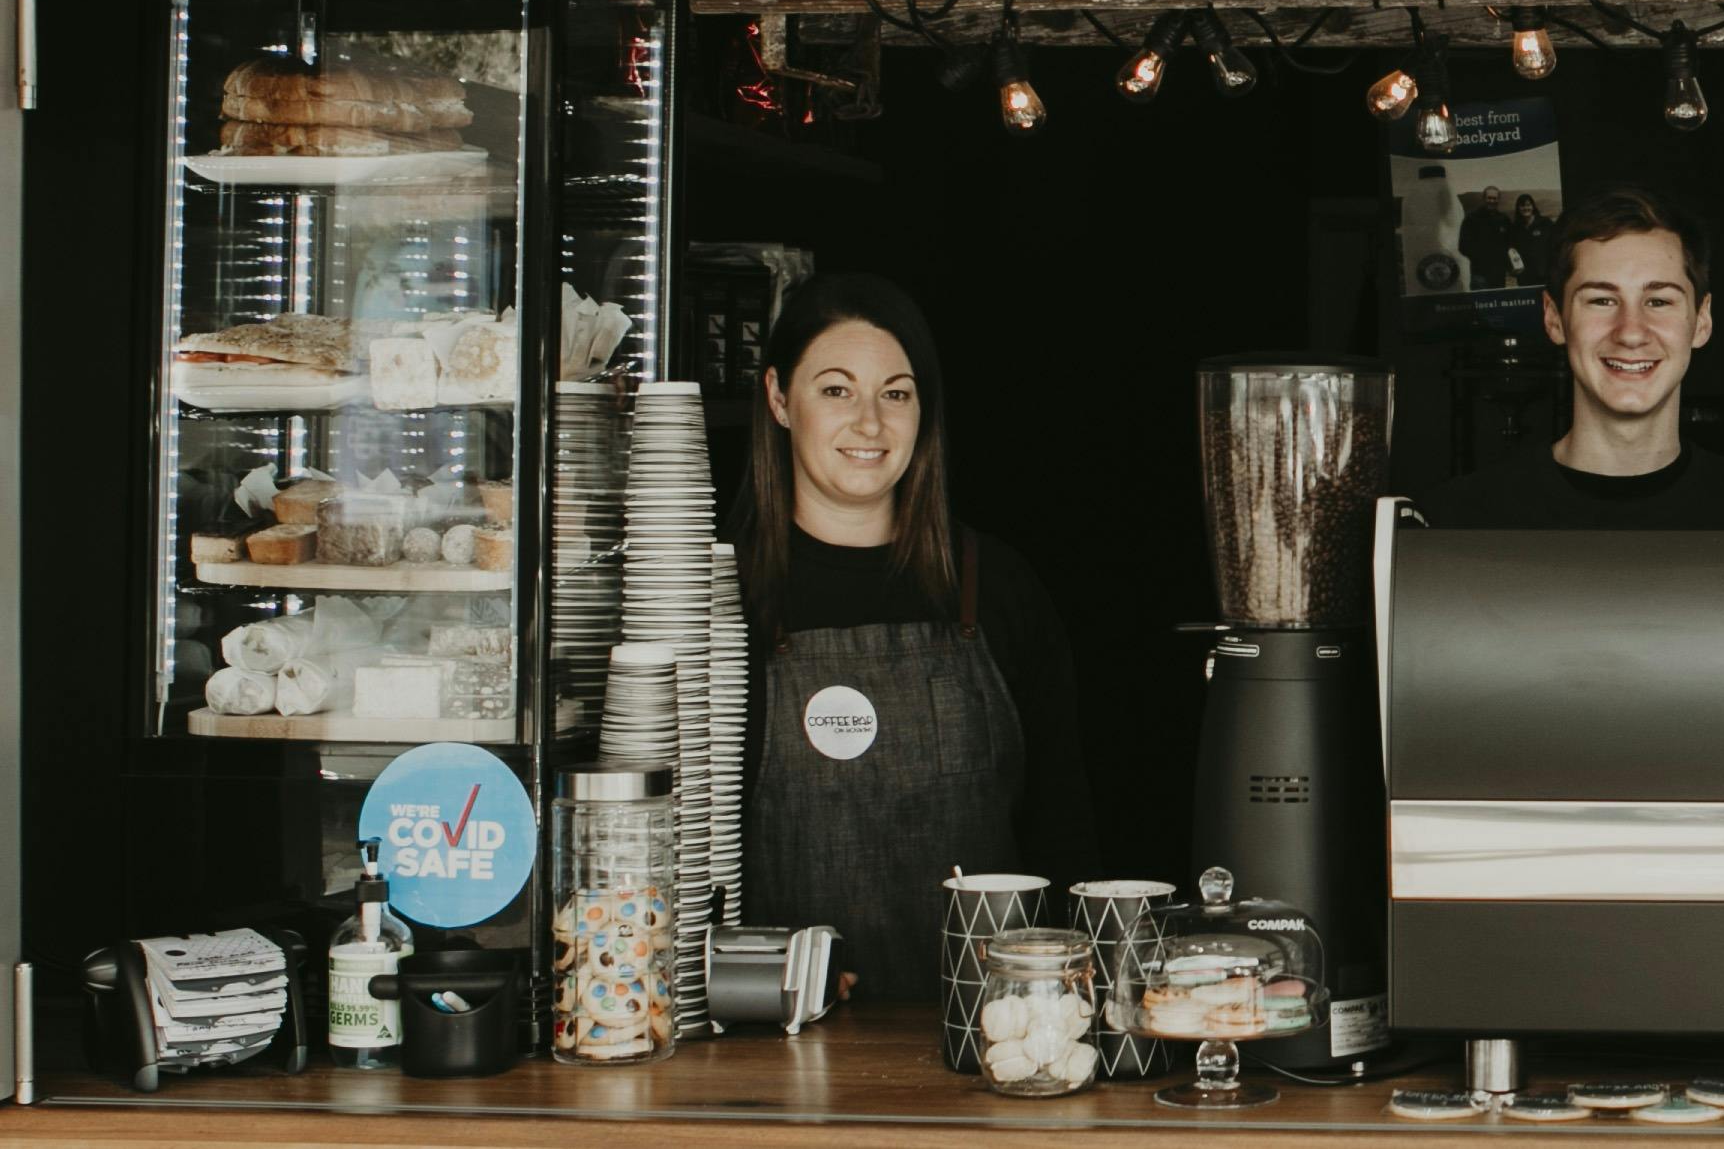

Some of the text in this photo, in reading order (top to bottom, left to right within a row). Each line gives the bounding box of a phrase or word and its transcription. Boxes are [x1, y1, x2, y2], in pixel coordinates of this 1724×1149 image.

[1455, 111, 1520, 127] best from
[1501, 298, 1536, 308] matters
[808, 716, 851, 727] COFFEE
[390, 804, 441, 819] WE'RE
[396, 847, 495, 881] SAFE
[1248, 919, 1305, 931] COMPAK
[330, 1010, 379, 1026] GERMS
